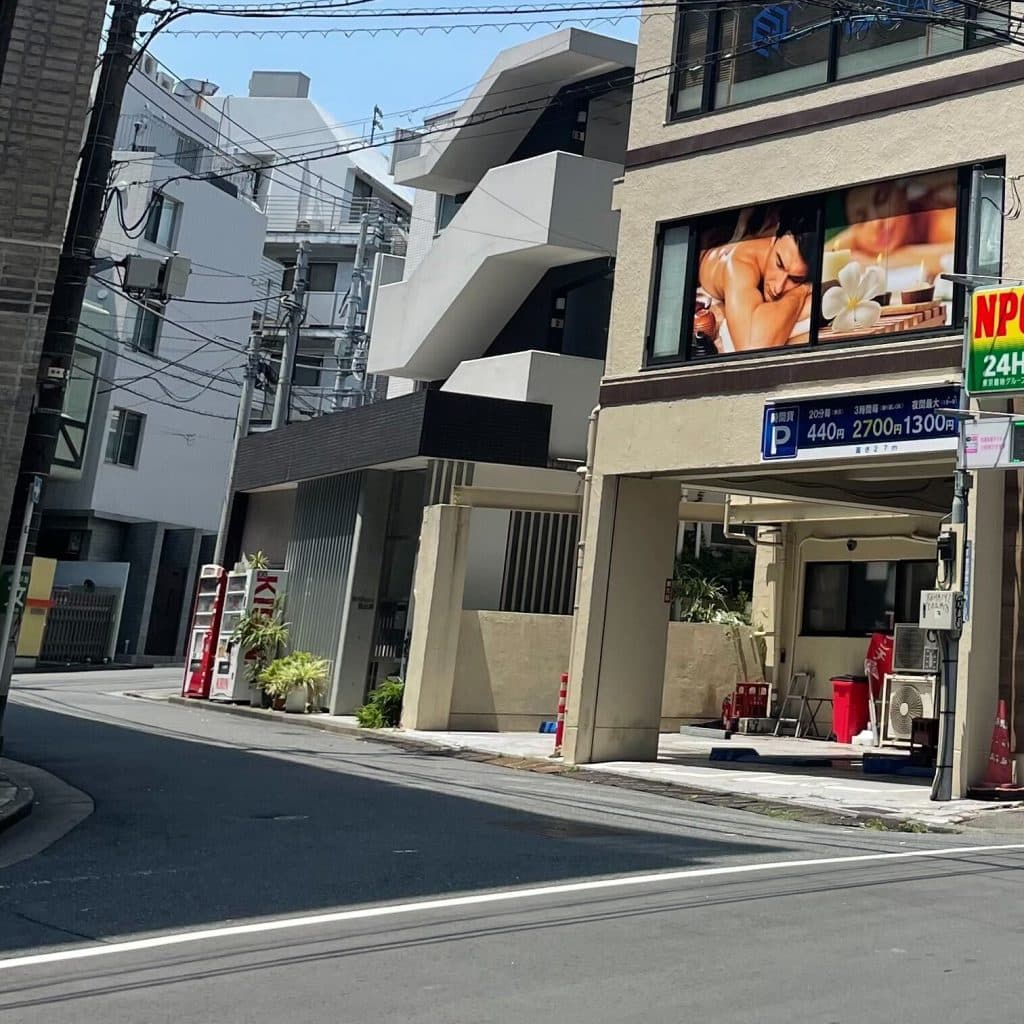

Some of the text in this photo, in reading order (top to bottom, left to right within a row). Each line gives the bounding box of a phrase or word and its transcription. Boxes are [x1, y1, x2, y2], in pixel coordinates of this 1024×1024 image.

[807, 422, 845, 442] 440円
[853, 417, 902, 438] 2700円
[904, 414, 955, 435] 1300円
[771, 425, 791, 455] P
